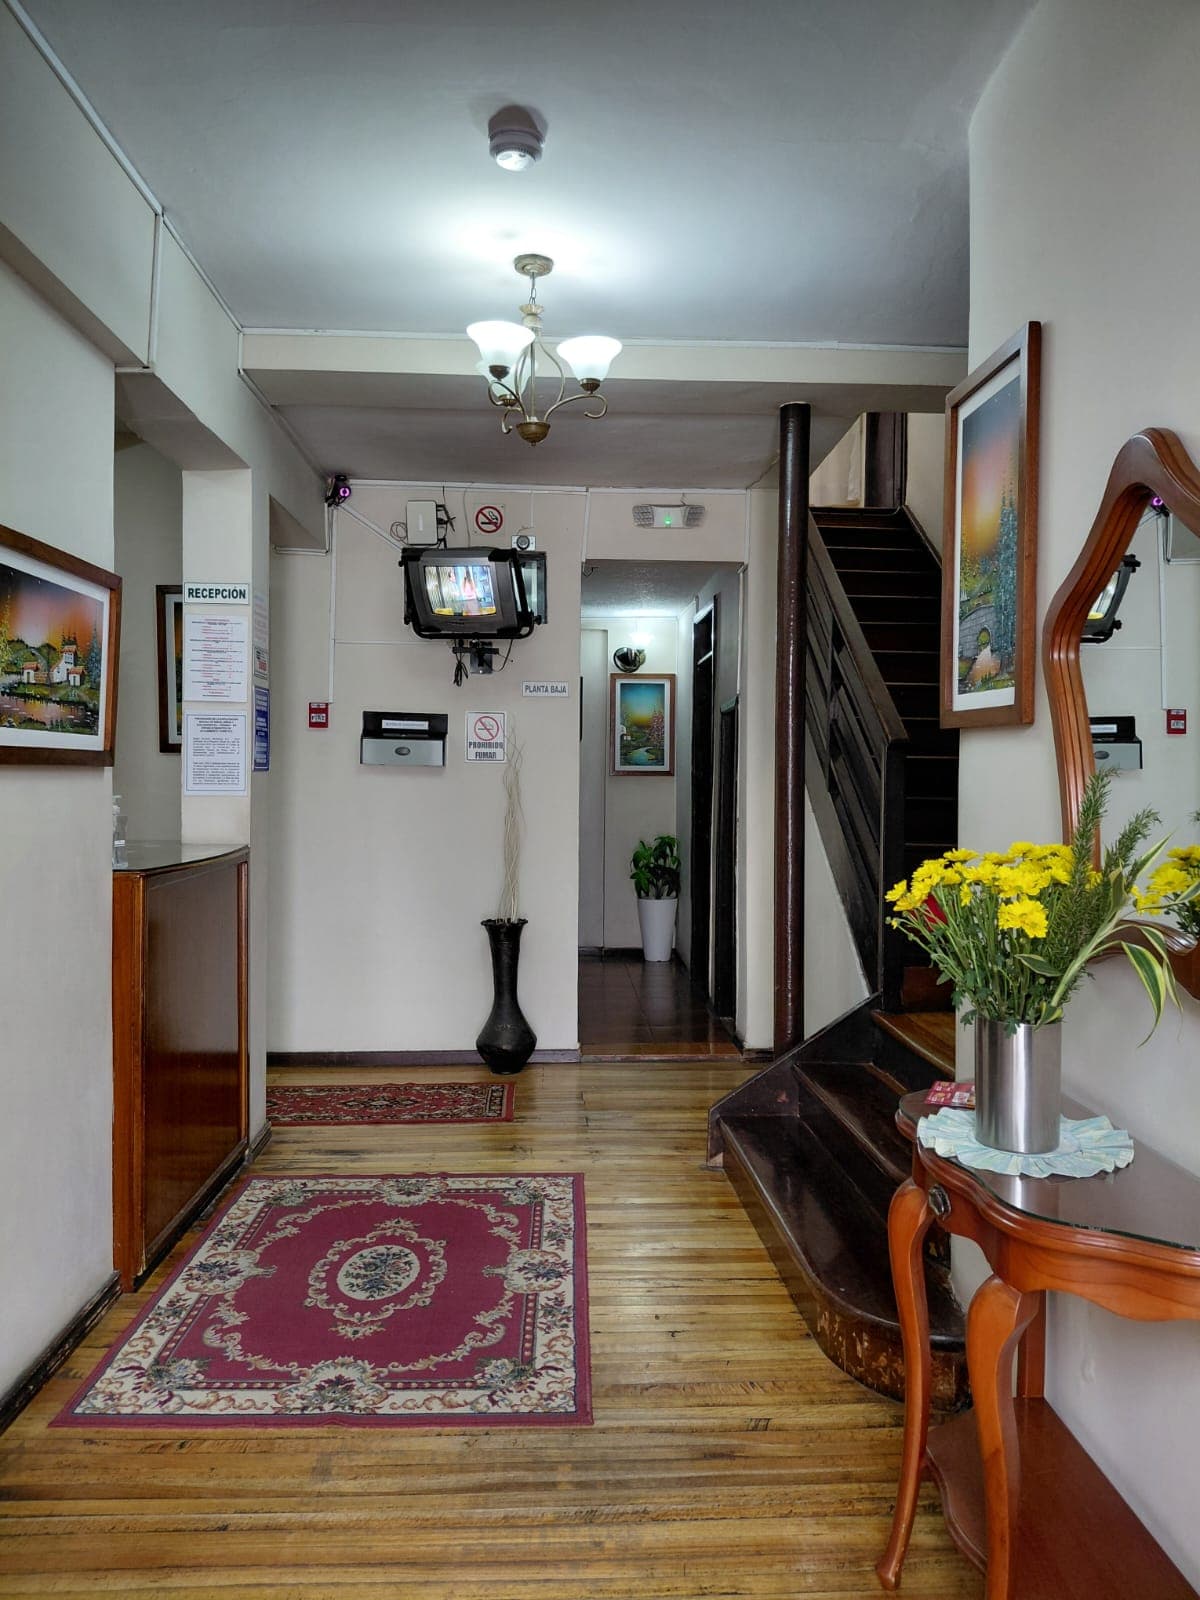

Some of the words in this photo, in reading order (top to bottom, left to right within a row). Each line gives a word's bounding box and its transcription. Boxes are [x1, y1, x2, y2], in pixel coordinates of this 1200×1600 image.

[188, 586, 246, 599] RECEPCIÓN
[525, 685, 549, 693] PLANTA
[551, 685, 567, 693] BAJA
[475, 751, 497, 759] FUMAR
